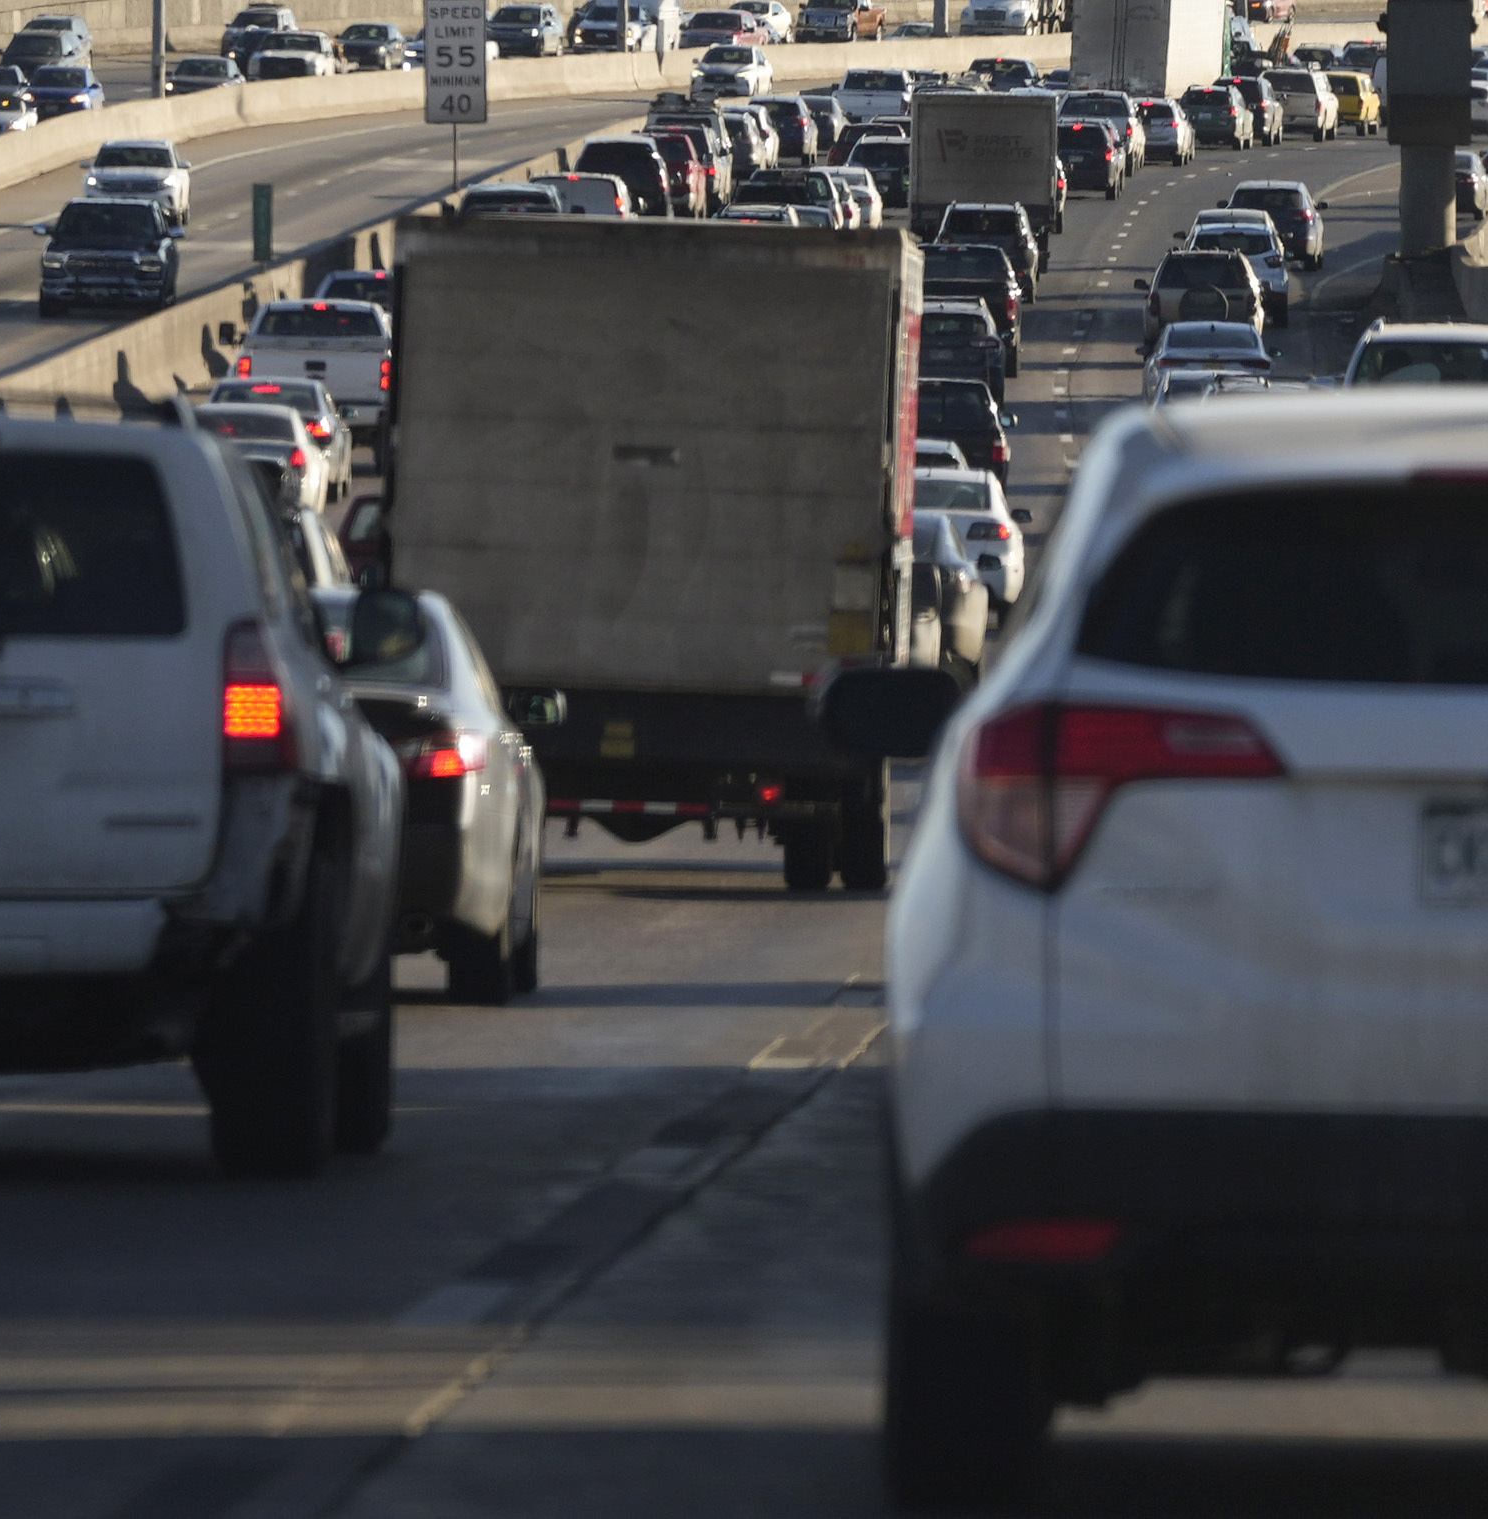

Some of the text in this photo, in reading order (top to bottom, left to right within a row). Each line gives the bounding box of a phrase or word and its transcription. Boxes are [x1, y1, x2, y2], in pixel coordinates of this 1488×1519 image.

[430, 7, 481, 19] SPEED
[435, 27, 474, 38] LIMIT
[437, 46, 475, 67] 55
[431, 76, 480, 86] MINIMUM
[440, 94, 472, 116] 40
[974, 134, 1022, 146] FIRST
[974, 147, 1033, 158] ONSITE
